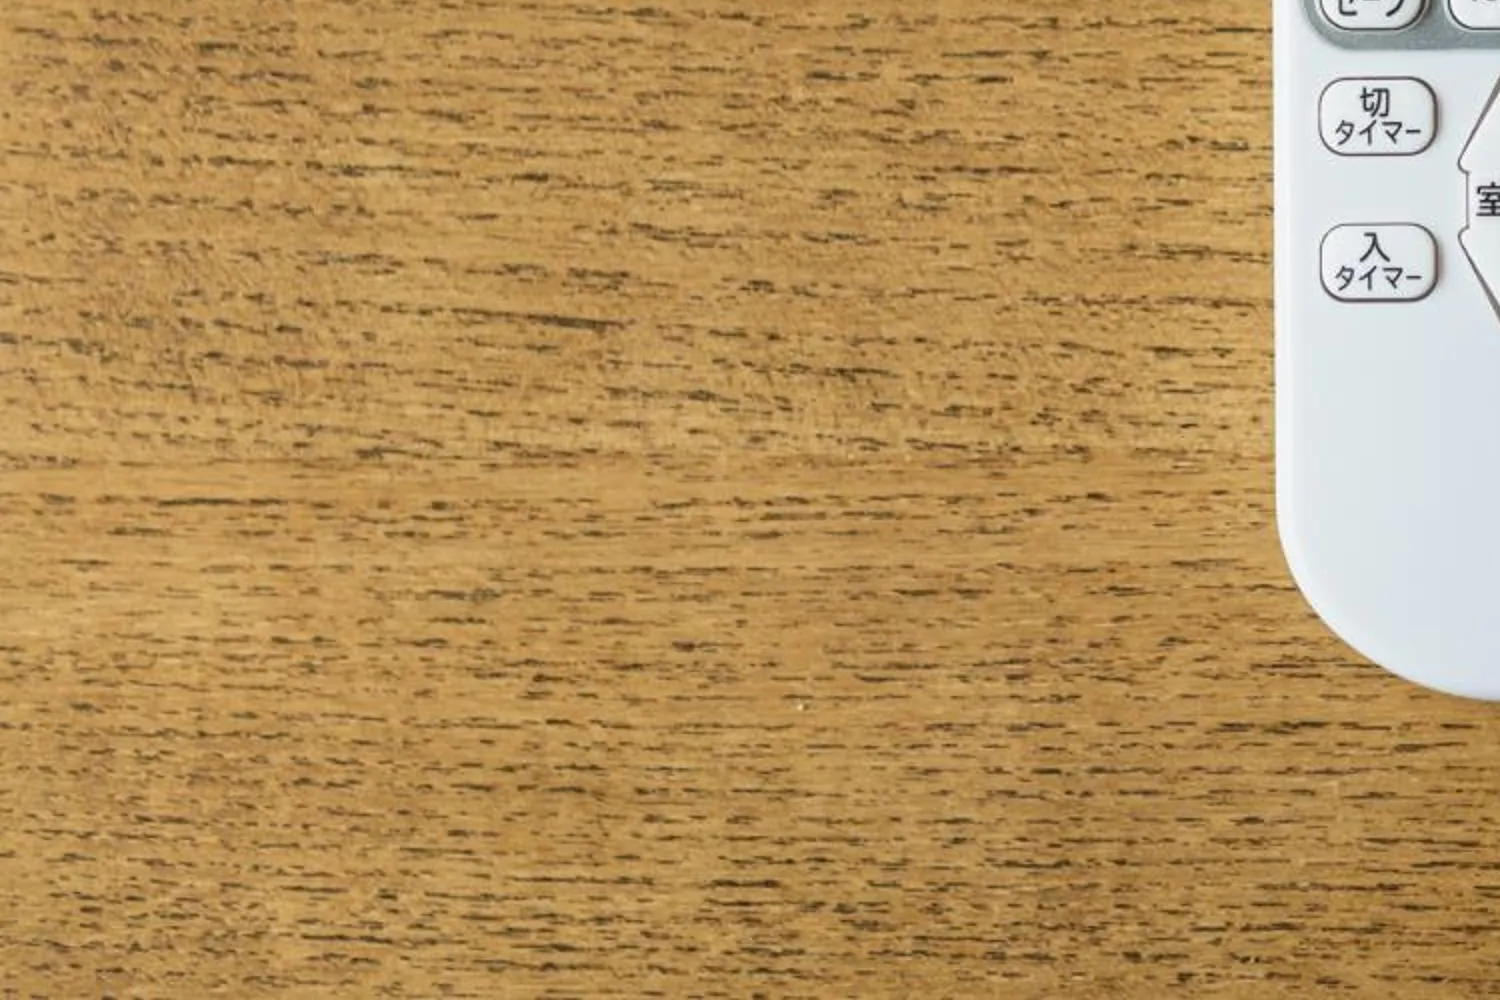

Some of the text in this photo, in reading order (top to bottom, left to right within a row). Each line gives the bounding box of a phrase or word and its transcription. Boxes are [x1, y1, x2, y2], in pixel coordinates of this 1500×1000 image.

[1359, 87, 1391, 118] 切
[1335, 119, 1422, 146] タイマー
[1359, 232, 1391, 263] 入
[1335, 265, 1422, 291] タイマー
